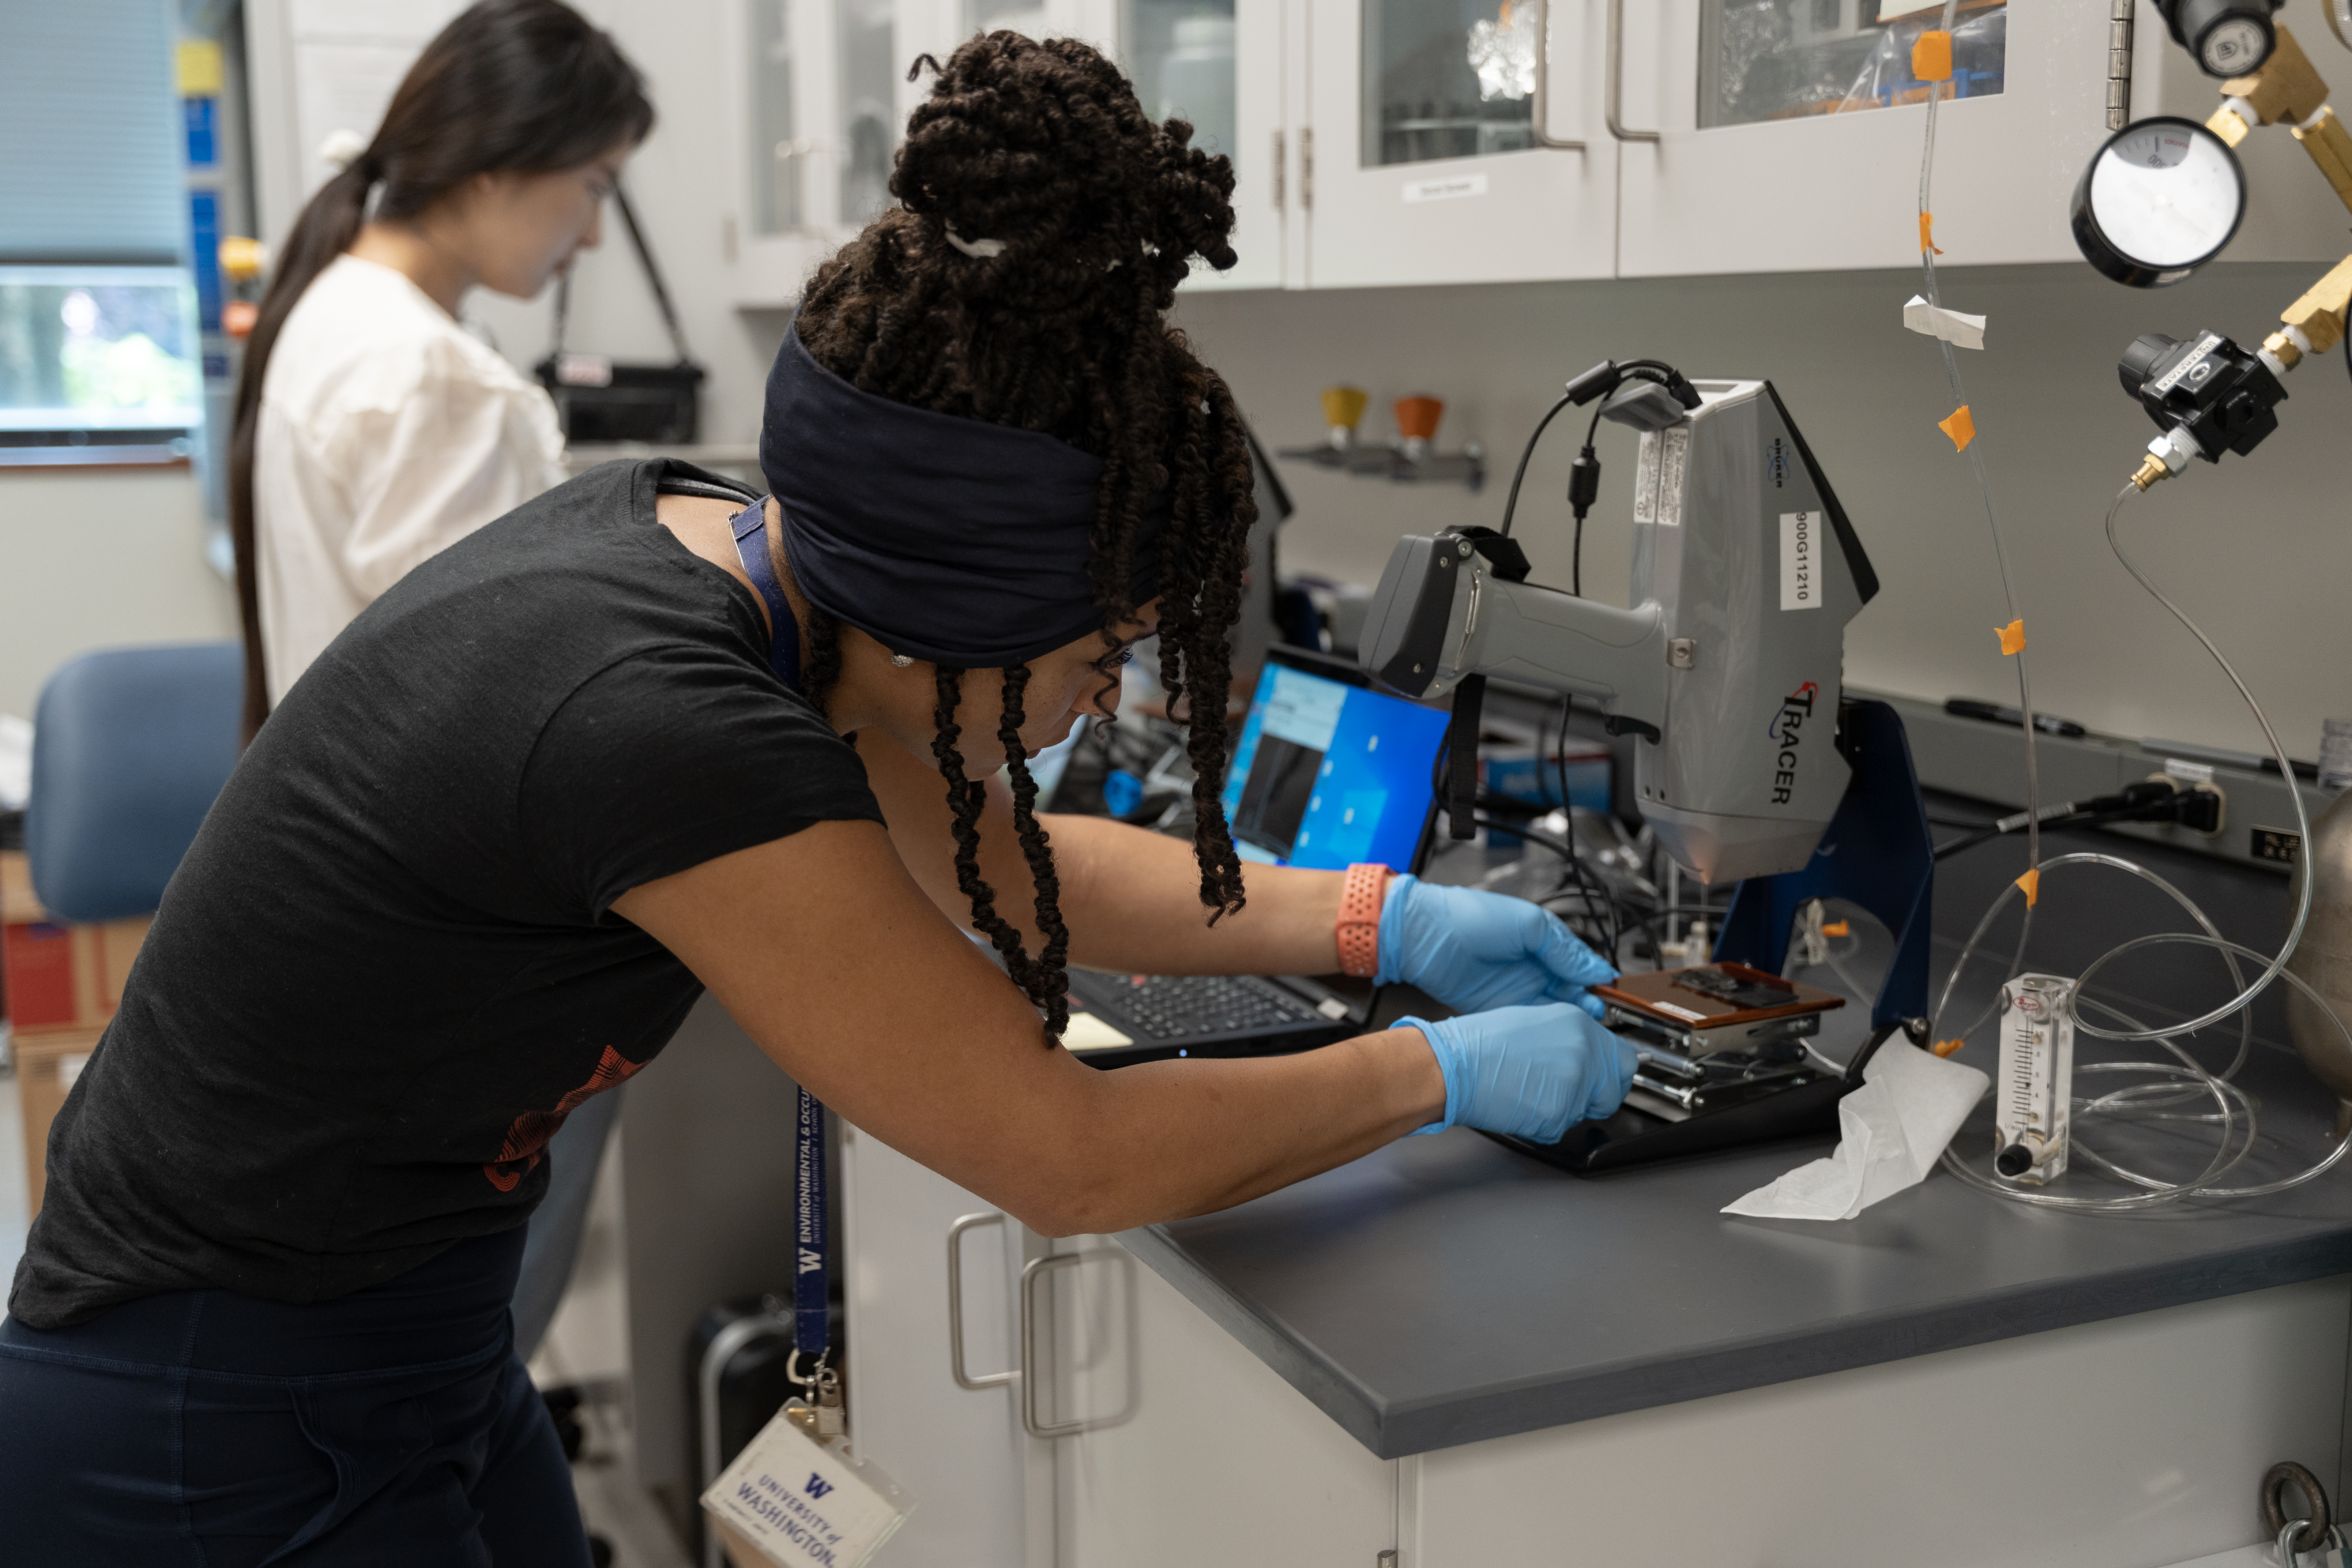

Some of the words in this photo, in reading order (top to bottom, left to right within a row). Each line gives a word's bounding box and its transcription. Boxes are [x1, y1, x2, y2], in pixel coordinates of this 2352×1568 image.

[2162, 342, 2215, 388] INTERSTATE
[1796, 512, 1808, 600] 900G11210
[1771, 690, 1813, 804] TRACER
[801, 1127, 810, 1136] &
[811, 1107, 819, 1134] SCHOOL
[798, 1139, 811, 1243] ENVIRONMENTAL
[811, 1146, 819, 1192] WASHINGTON
[811, 1203, 821, 1244] UNIVERSITY
[798, 1248, 821, 1274] W
[804, 1471, 834, 1499] W
[737, 1482, 836, 1566] WASHINGTON
[758, 1474, 831, 1534] UNIVERSITY
[825, 1534, 843, 1545] of
